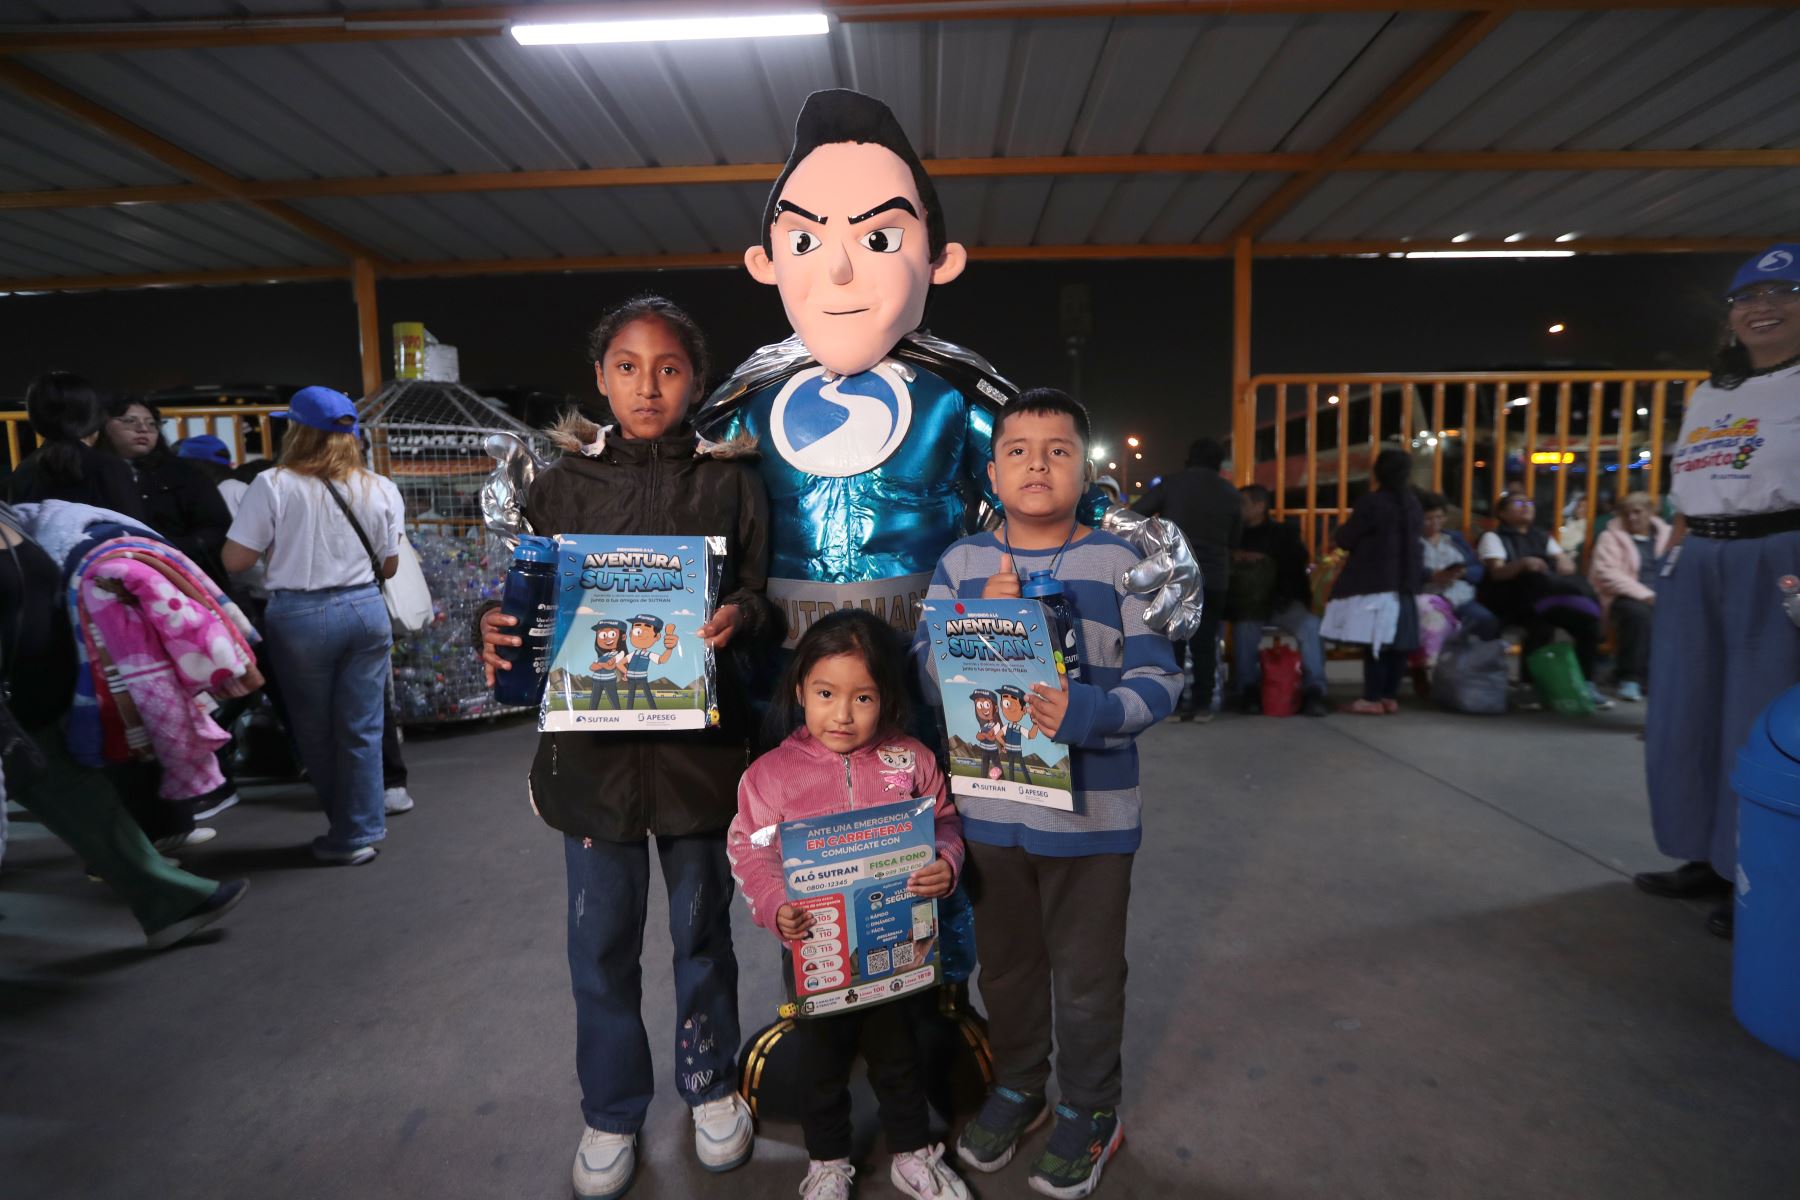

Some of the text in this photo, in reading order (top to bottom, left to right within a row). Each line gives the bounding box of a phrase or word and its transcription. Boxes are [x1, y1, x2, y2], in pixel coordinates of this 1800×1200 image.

[582, 552, 682, 571] AVENTURA
[580, 569, 684, 592] SUTRAN
[946, 618, 1028, 639] AVENTURA
[949, 637, 1035, 661] SUTRAN
[980, 784, 1048, 798] SUTRAN APESEG
[808, 812, 910, 838] ANTE UNA EMERGENCIA
[806, 822, 912, 850] EN CARRETERAS
[822, 836, 900, 858] COMUNÍCATE CON
[870, 851, 926, 870] FISCA FONO
[794, 865, 858, 884] ALÓ SUTRAN
[806, 879, 848, 892] 0800-12345
[820, 930, 832, 938] 110
